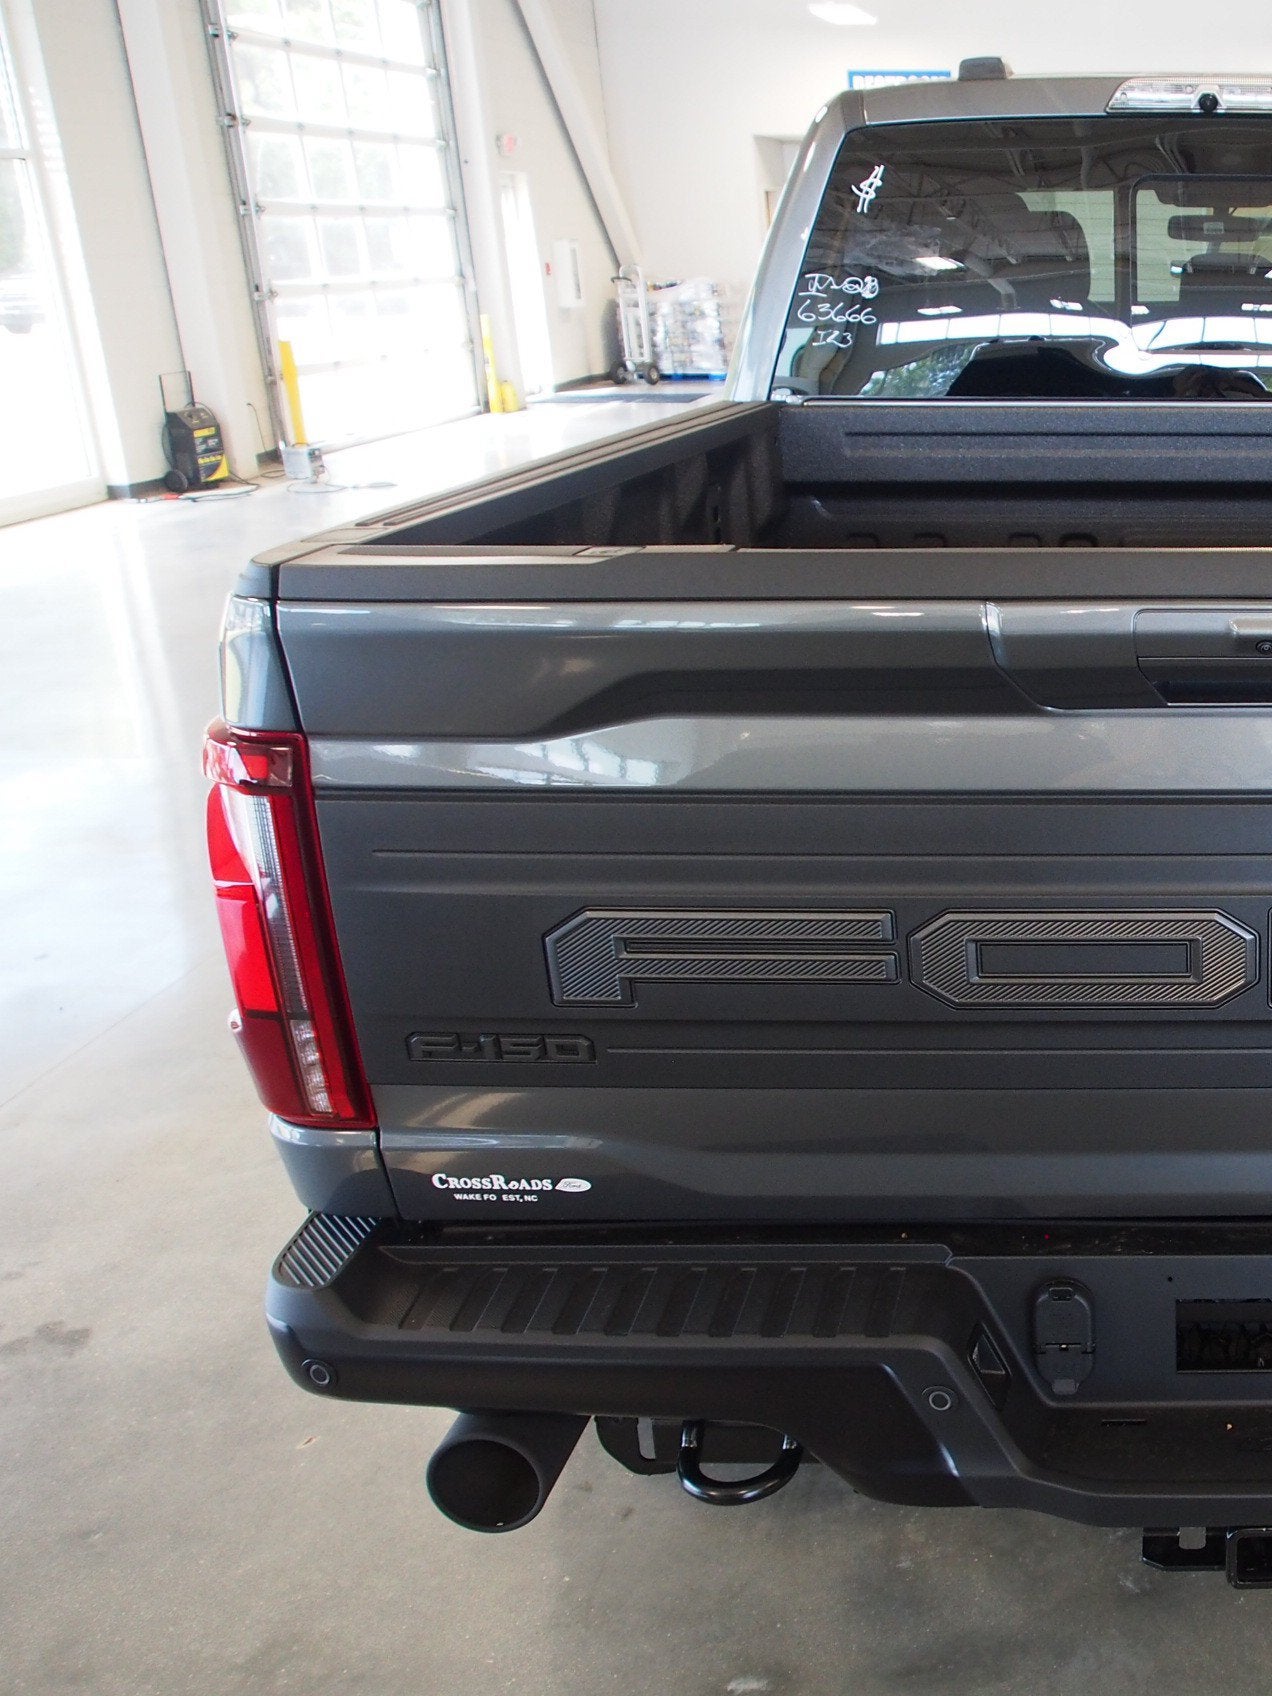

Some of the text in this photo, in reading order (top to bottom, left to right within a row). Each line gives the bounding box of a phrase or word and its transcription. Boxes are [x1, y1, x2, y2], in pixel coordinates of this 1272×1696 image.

[798, 299, 876, 324] 63666
[406, 1032, 597, 1065] F-150
[453, 1193, 482, 1201] WAKE
